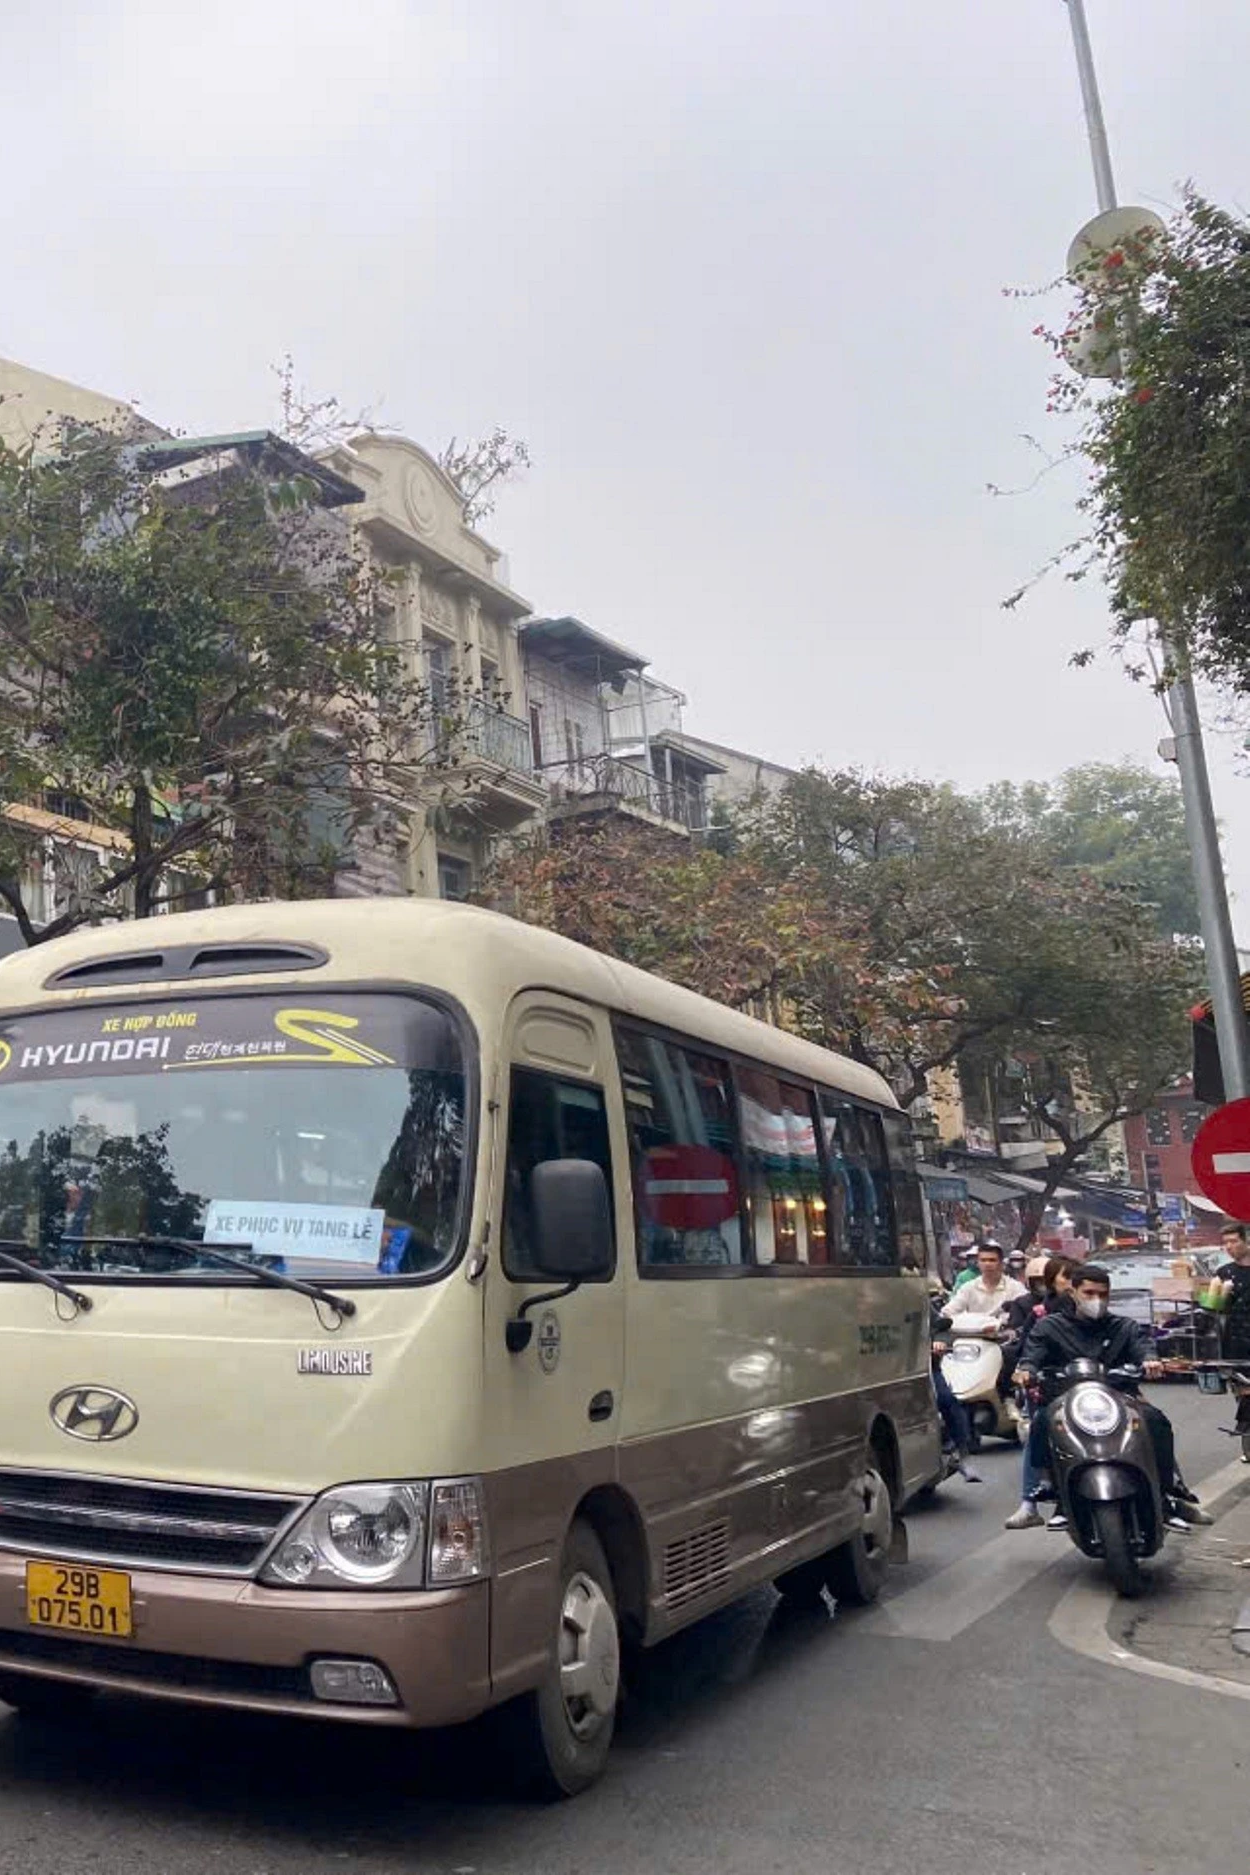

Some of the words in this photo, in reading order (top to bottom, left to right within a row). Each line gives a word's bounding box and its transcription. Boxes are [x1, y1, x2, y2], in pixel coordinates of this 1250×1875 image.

[101, 1017, 122, 1033] XE
[20, 1036, 171, 1069] HYUNDAI
[214, 1216, 234, 1232] XE
[237, 1216, 279, 1237] PHỤC
[283, 1218, 304, 1237] VỤ
[308, 1219, 350, 1237] TANG
[297, 1349, 373, 1376] LIMOUSINE
[55, 1570, 99, 1599] 29B
[38, 1597, 117, 1632] 075.01
